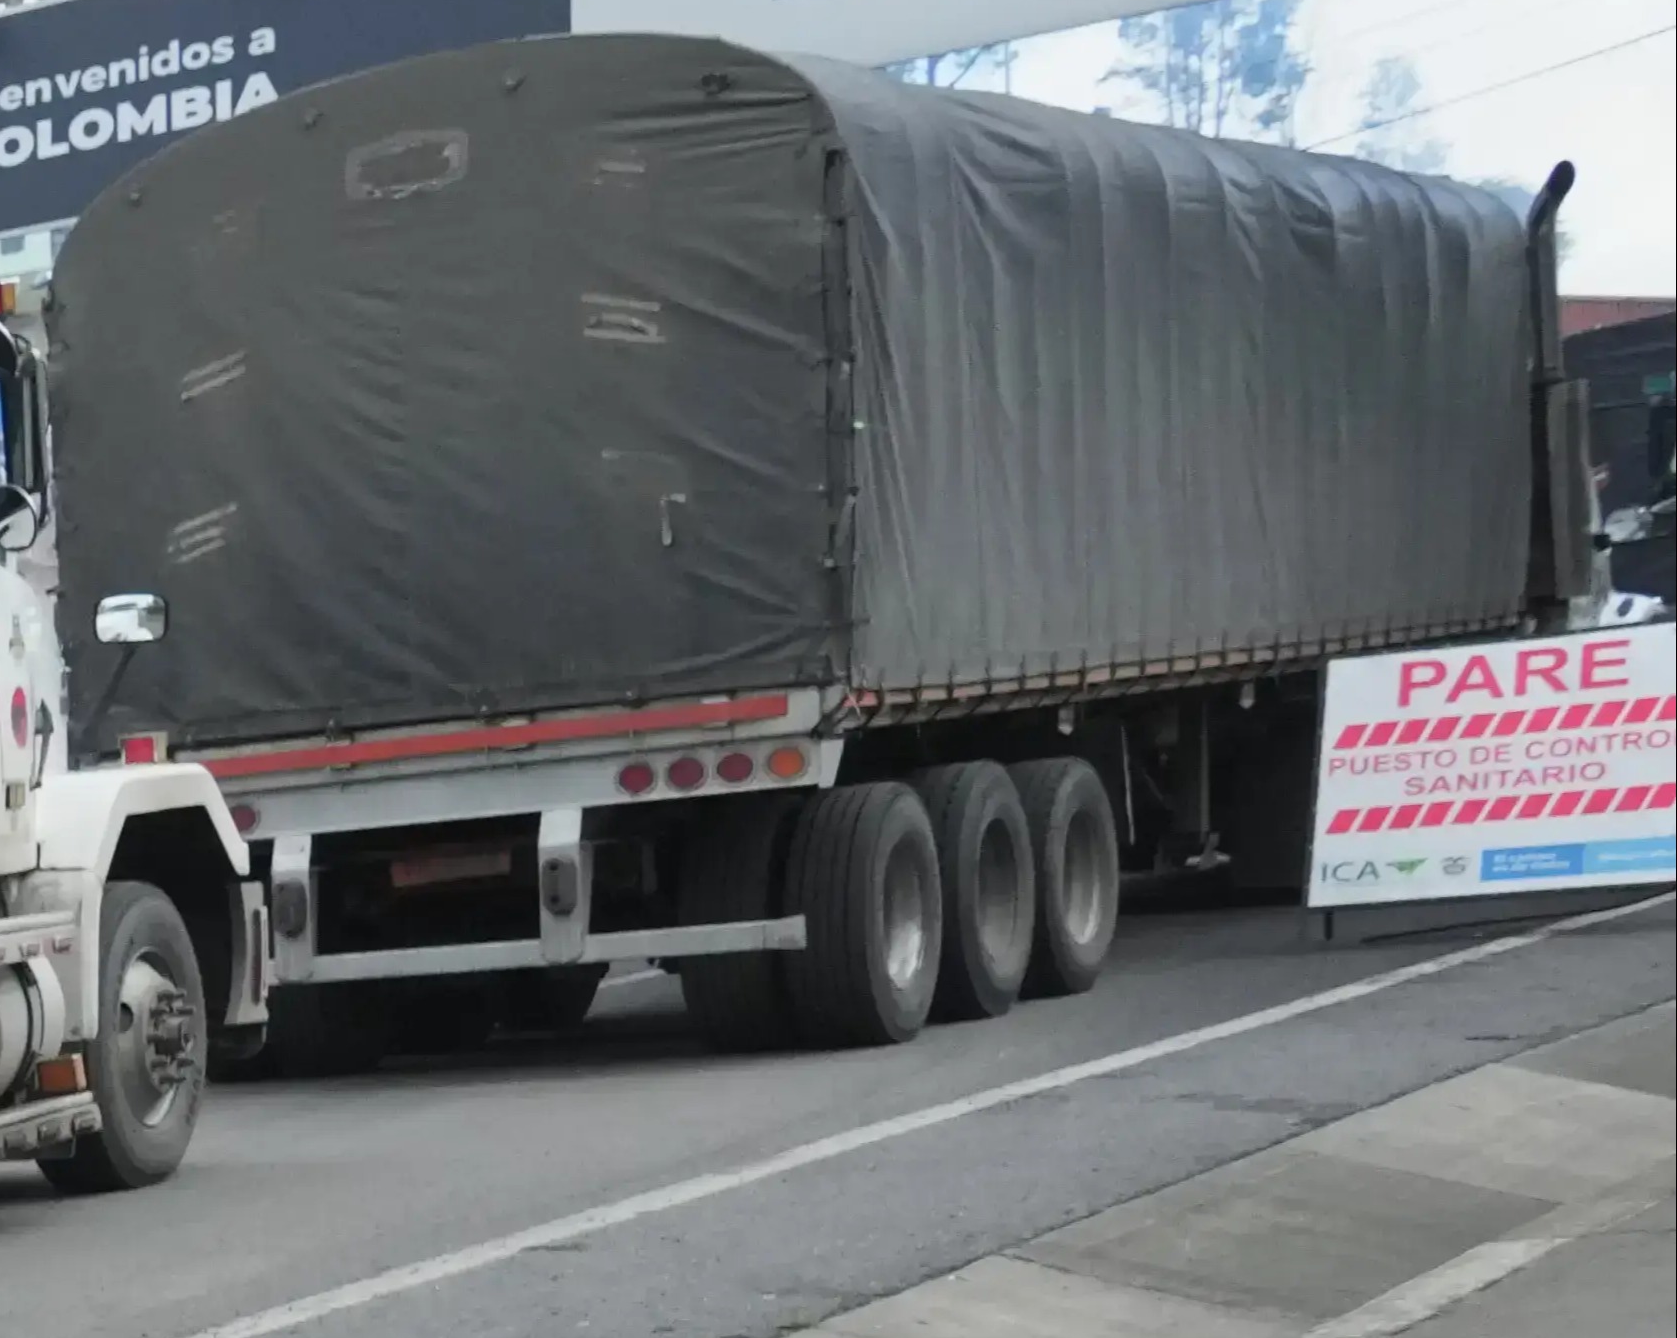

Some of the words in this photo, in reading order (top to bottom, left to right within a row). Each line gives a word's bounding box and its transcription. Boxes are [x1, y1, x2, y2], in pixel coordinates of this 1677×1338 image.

[248, 27, 276, 56] a
[1397, 639, 1630, 708] PARE
[1328, 748, 1457, 778] PUESTO
[1469, 743, 1513, 766] DE
[1525, 728, 1675, 760] CONTRO
[1403, 761, 1606, 797] SANITARIO
[1320, 861, 1380, 883] ICA
